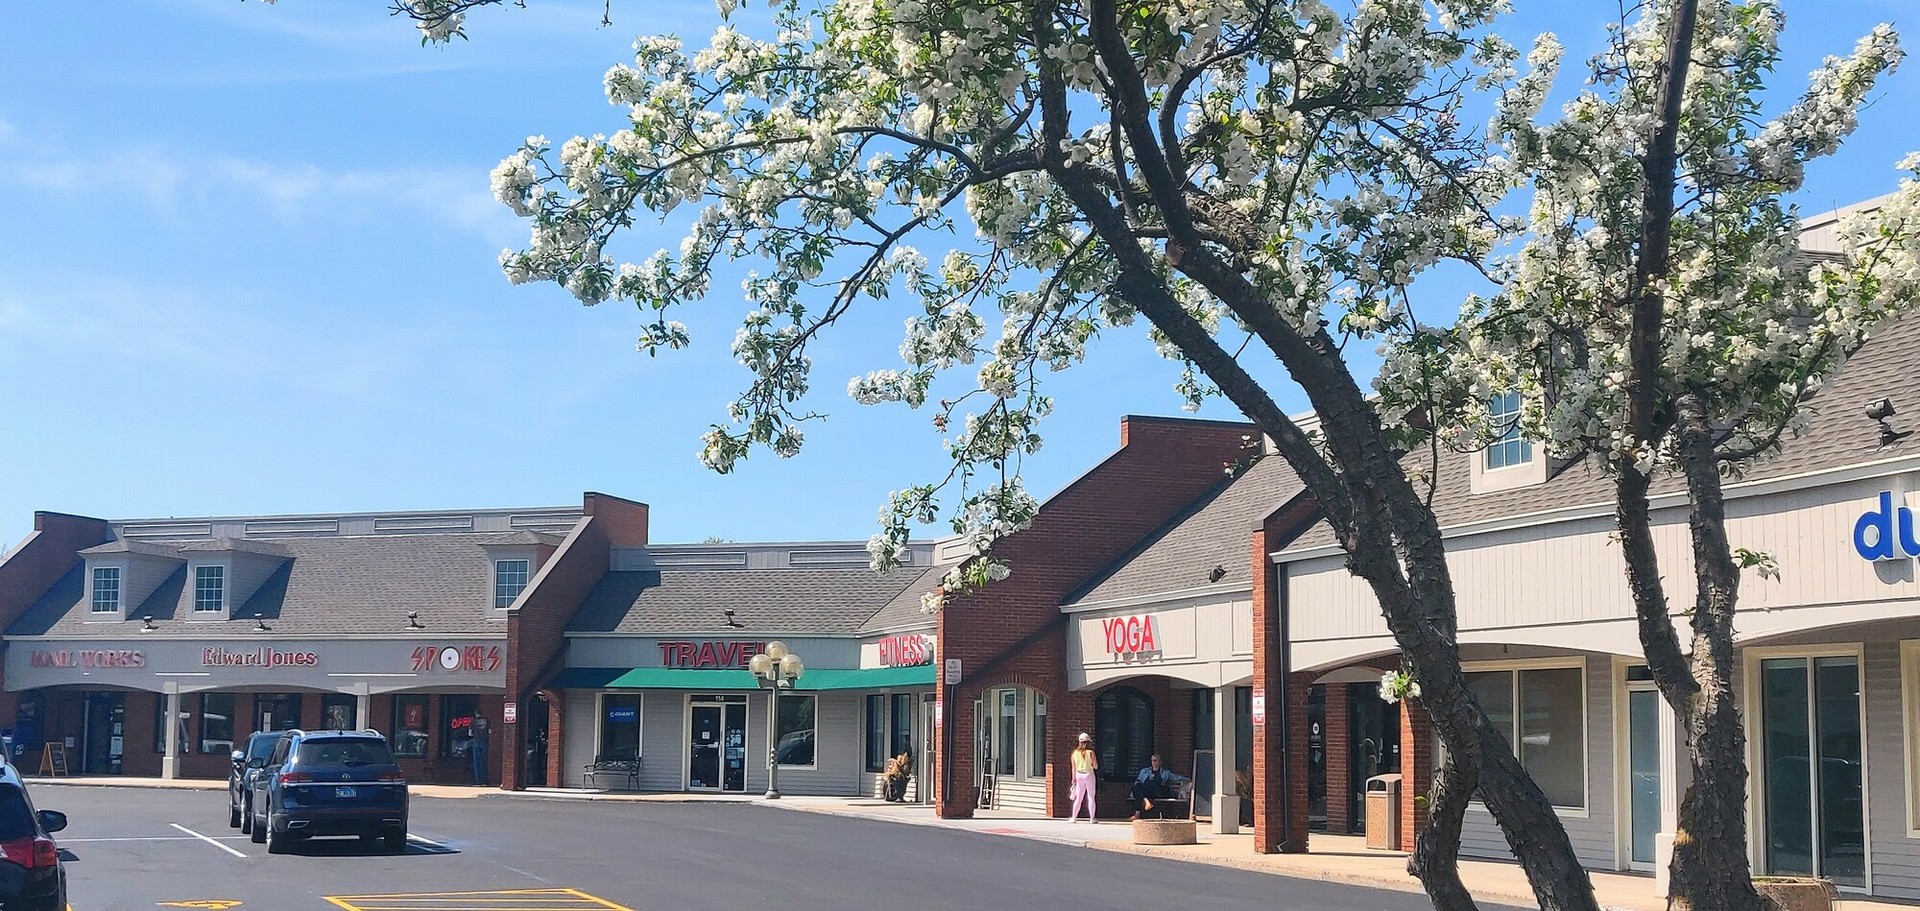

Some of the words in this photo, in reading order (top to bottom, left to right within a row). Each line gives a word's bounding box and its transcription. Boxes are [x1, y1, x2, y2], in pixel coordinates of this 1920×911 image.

[1102, 615, 1155, 653] YOGA
[78, 649, 145, 669] WORKS
[202, 646, 264, 667] Edward
[264, 646, 319, 670] Jones
[410, 644, 501, 672] SPOKES
[879, 633, 925, 666] FITNESS
